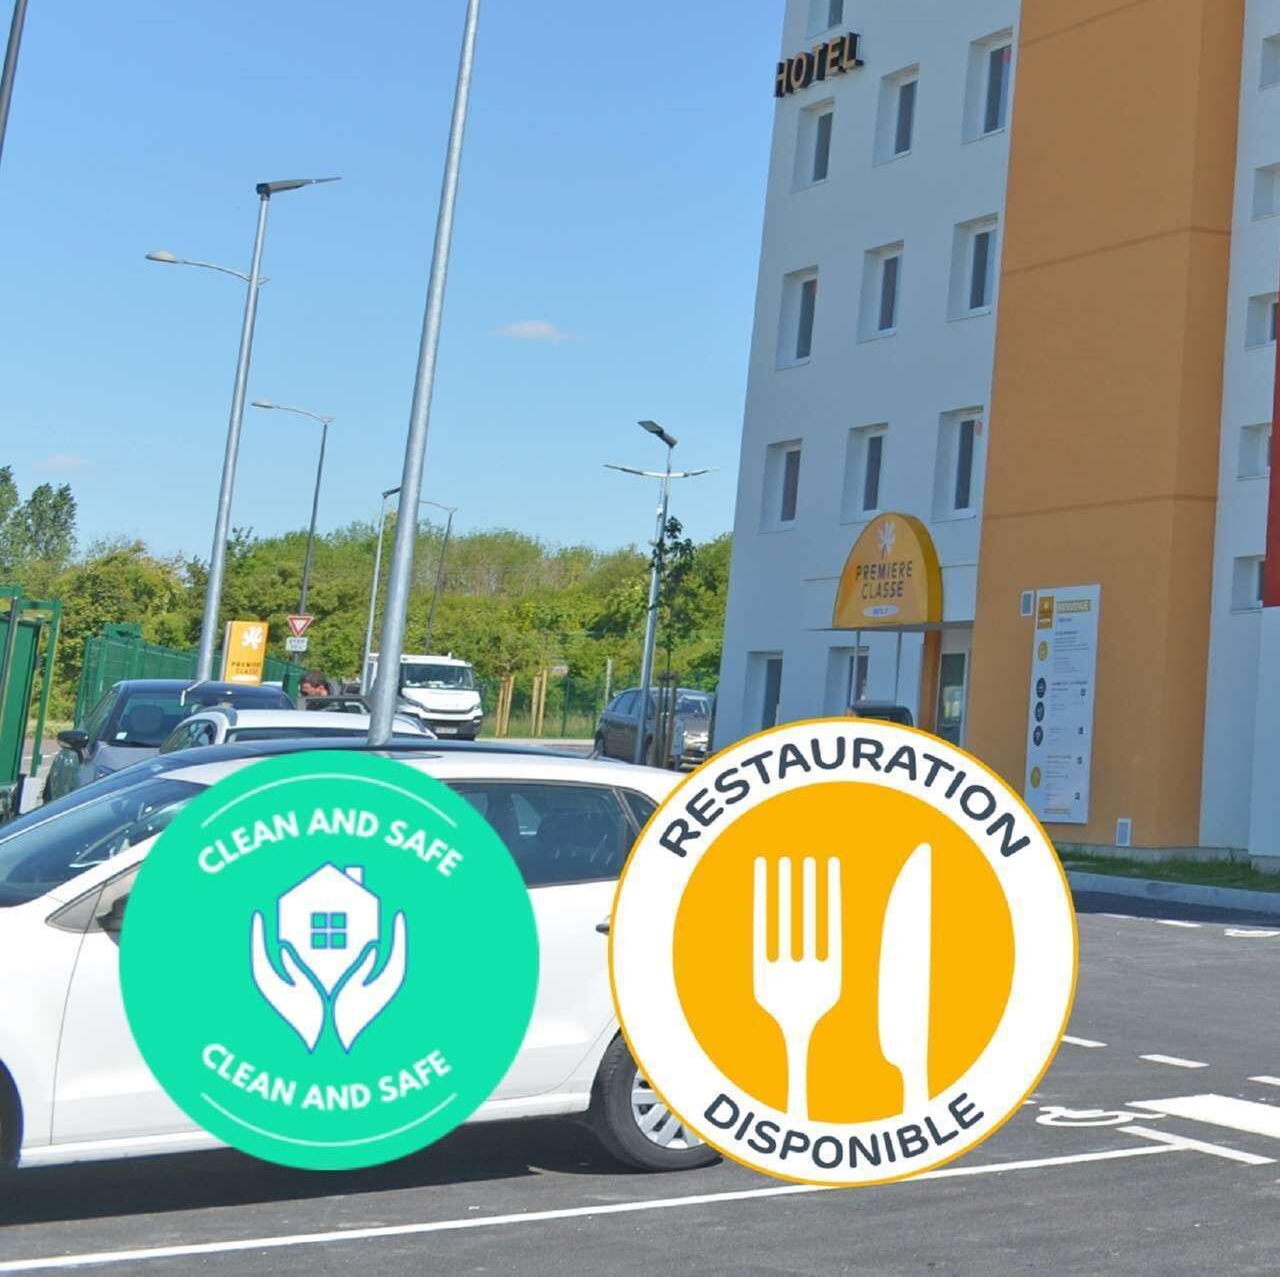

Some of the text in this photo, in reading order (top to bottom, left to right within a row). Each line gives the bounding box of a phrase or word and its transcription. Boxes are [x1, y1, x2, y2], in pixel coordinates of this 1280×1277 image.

[775, 31, 864, 98] HOTEL
[855, 560, 913, 581] PREMIERE
[861, 580, 904, 600] CLASSE
